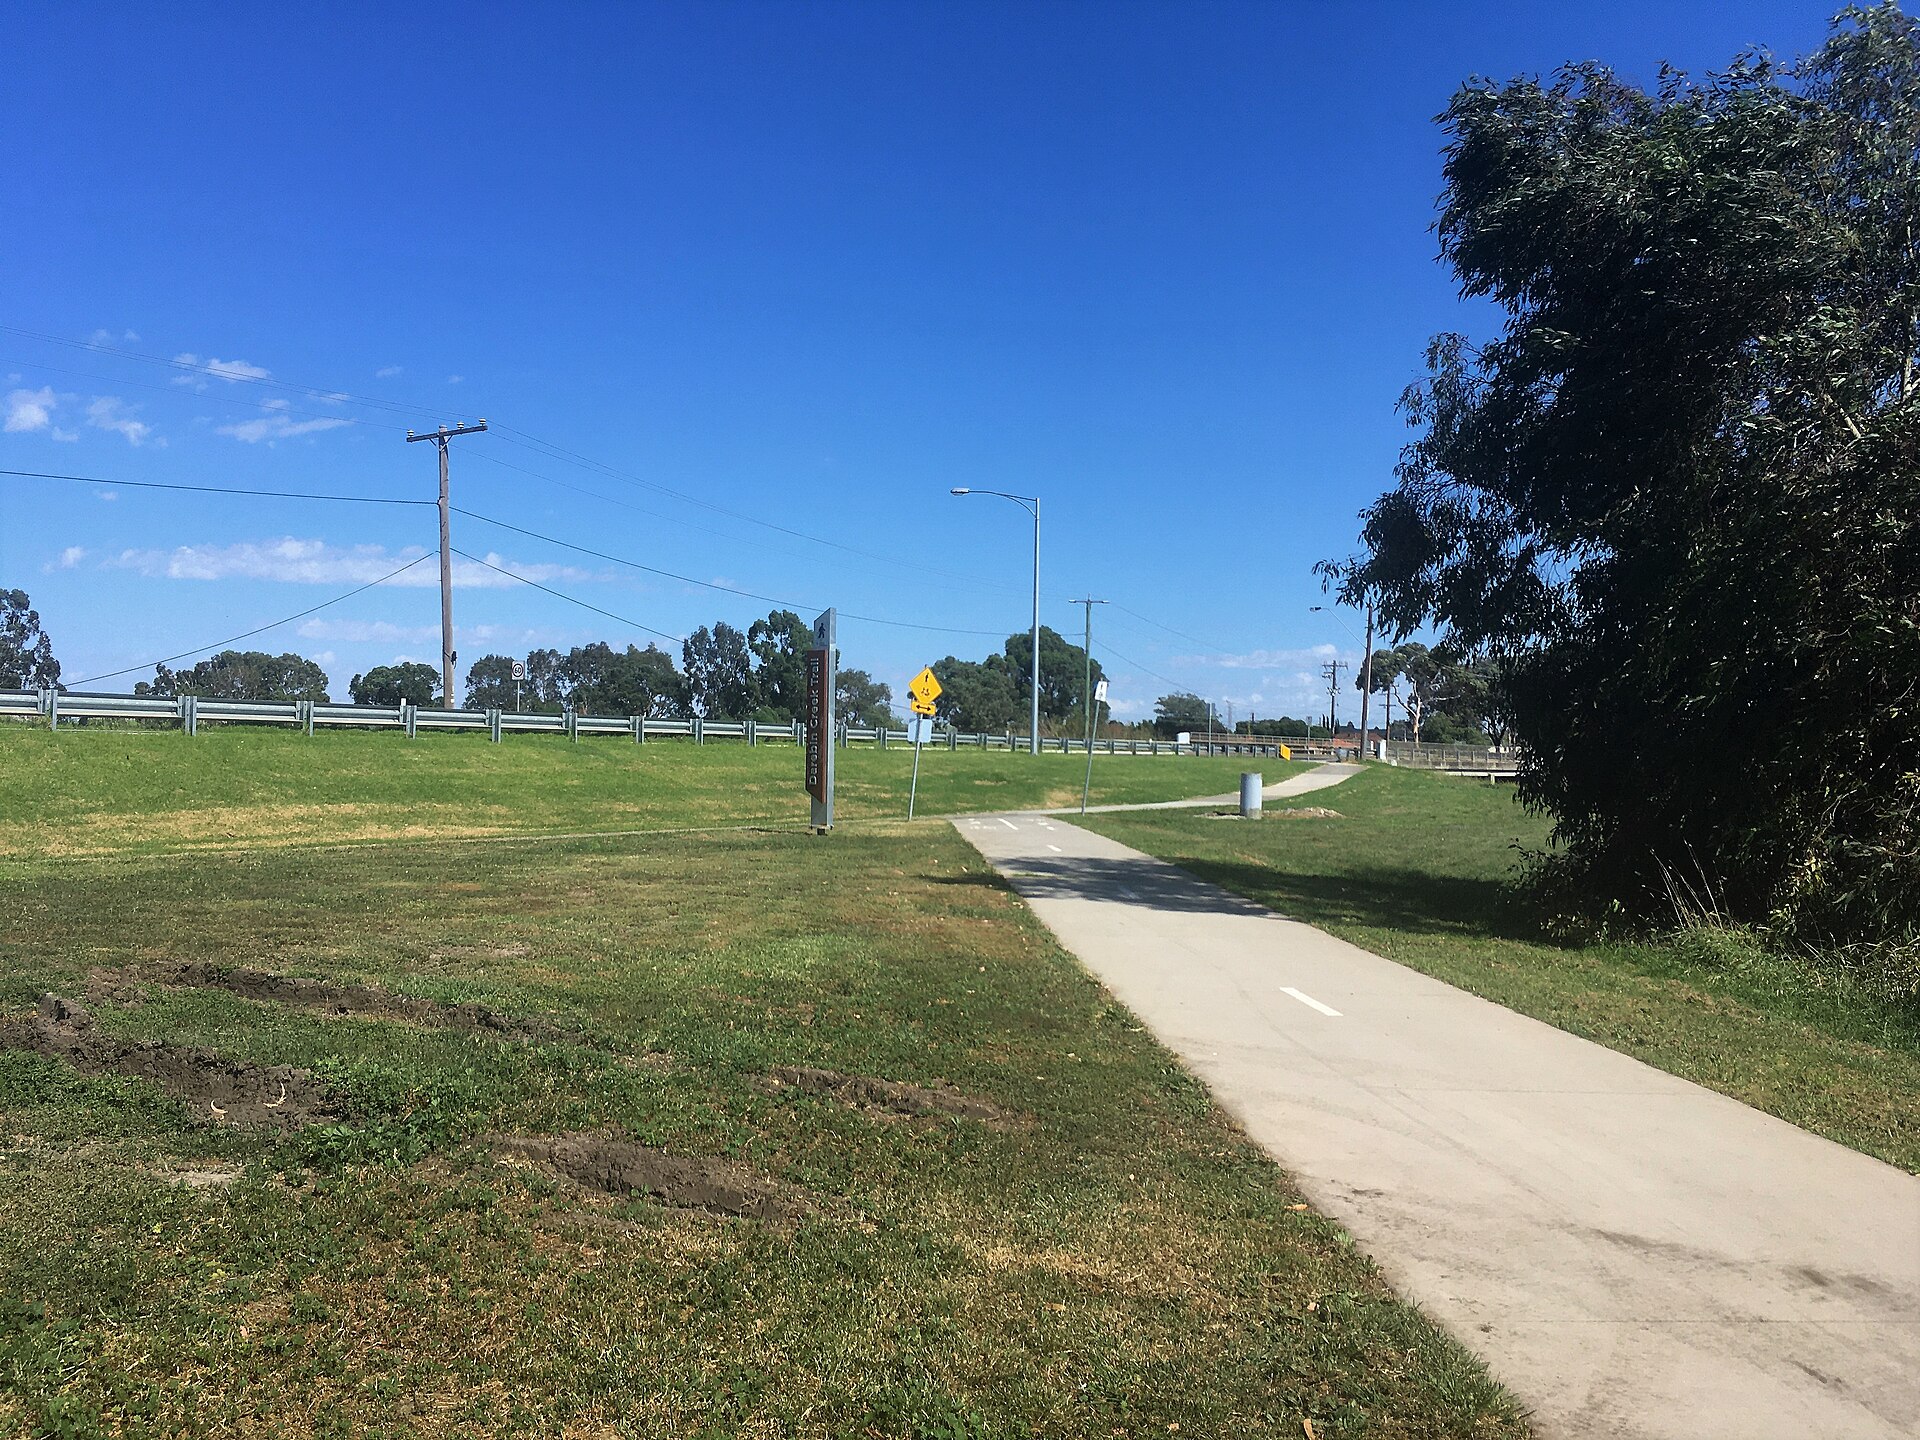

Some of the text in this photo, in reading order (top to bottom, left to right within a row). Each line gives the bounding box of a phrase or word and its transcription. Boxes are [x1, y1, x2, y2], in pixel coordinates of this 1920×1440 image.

[809, 657, 820, 786] Darebin Creek Trail
